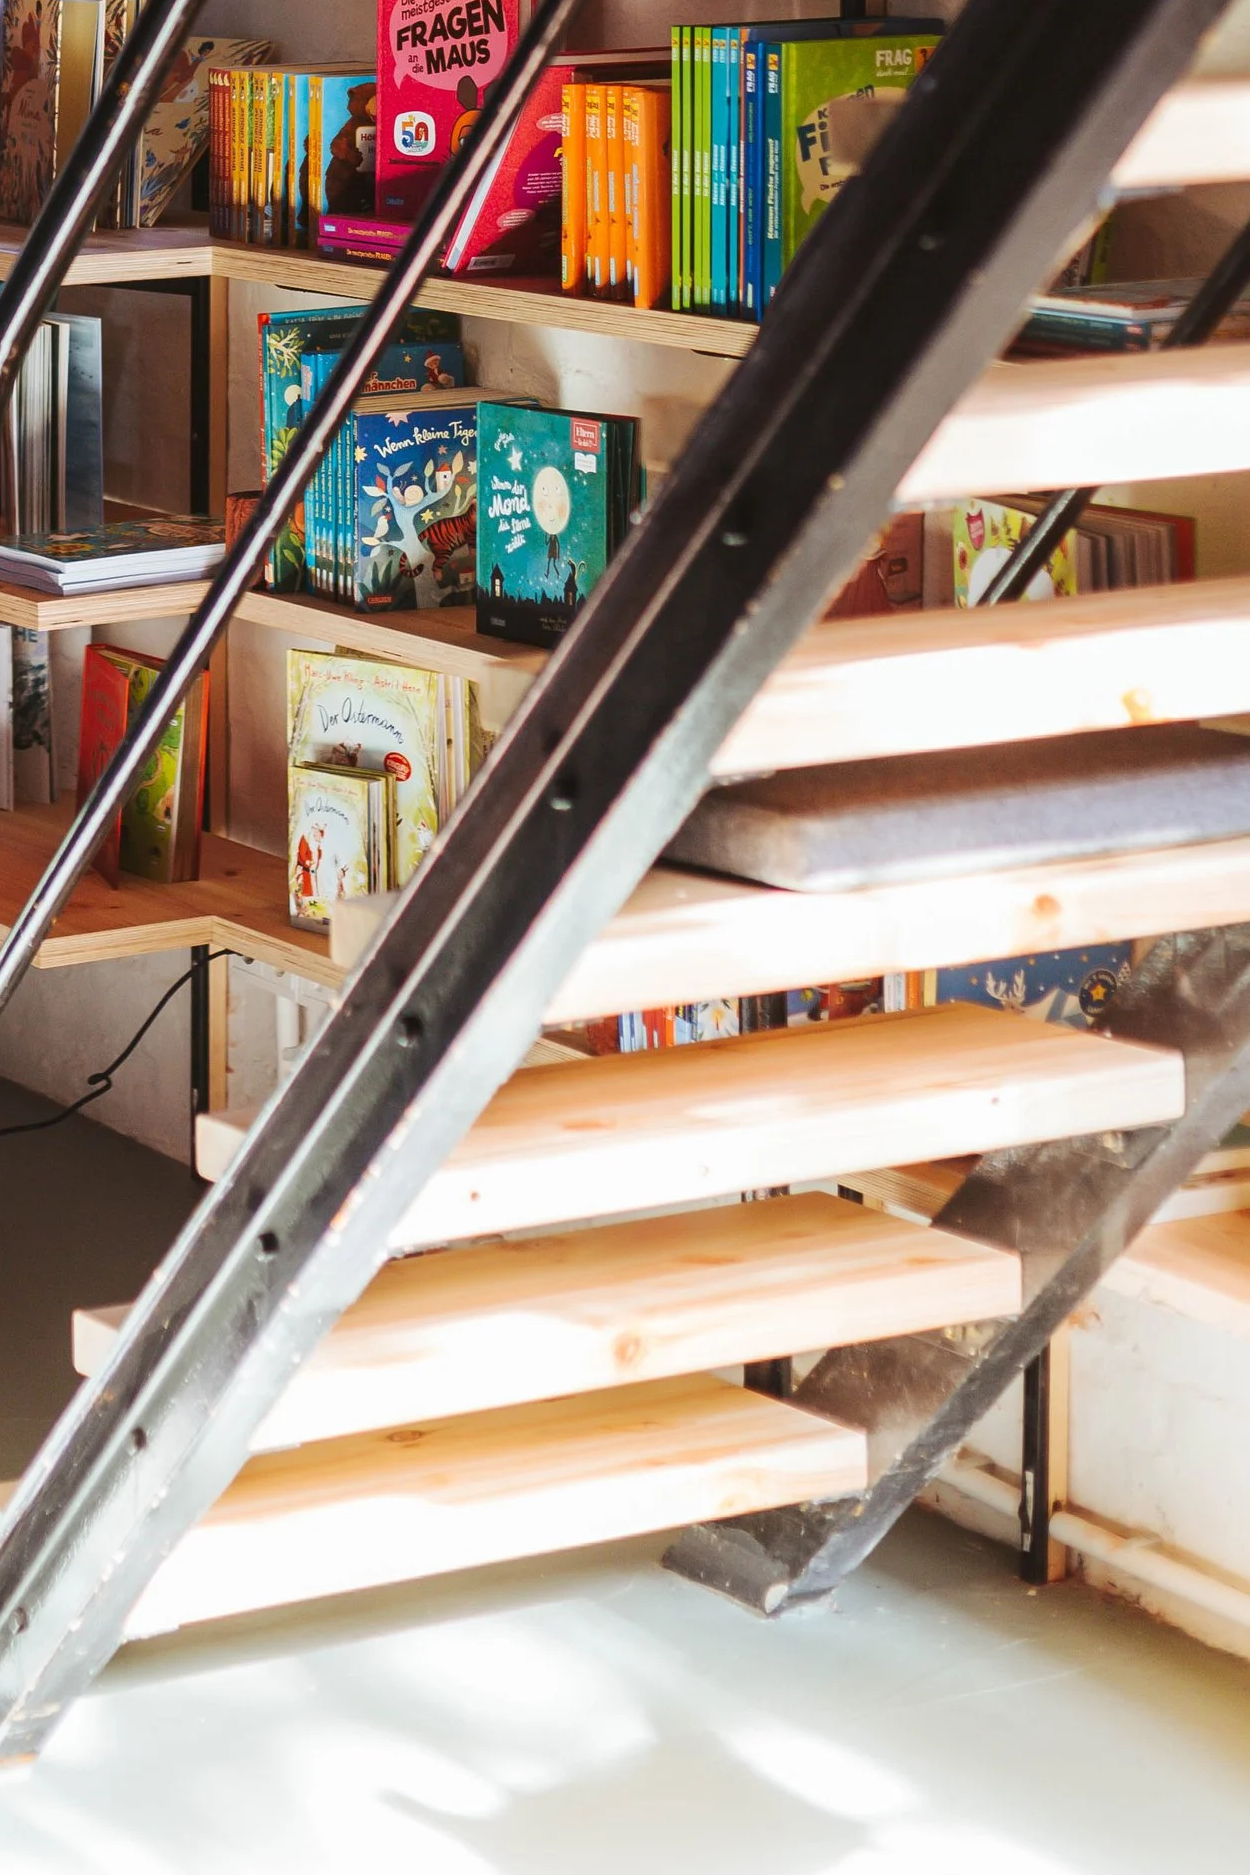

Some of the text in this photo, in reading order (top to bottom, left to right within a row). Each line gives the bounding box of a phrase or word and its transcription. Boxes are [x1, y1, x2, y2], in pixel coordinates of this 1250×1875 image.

[408, 54, 418, 63] an
[412, 38, 491, 75] die MAUS
[876, 49, 912, 67] FRAG
[362, 377, 417, 393] männchen
[374, 437, 414, 459] Wenn
[413, 427, 449, 444] kleine
[489, 493, 530, 519] Mond
[317, 697, 404, 744] Der Ostermann
